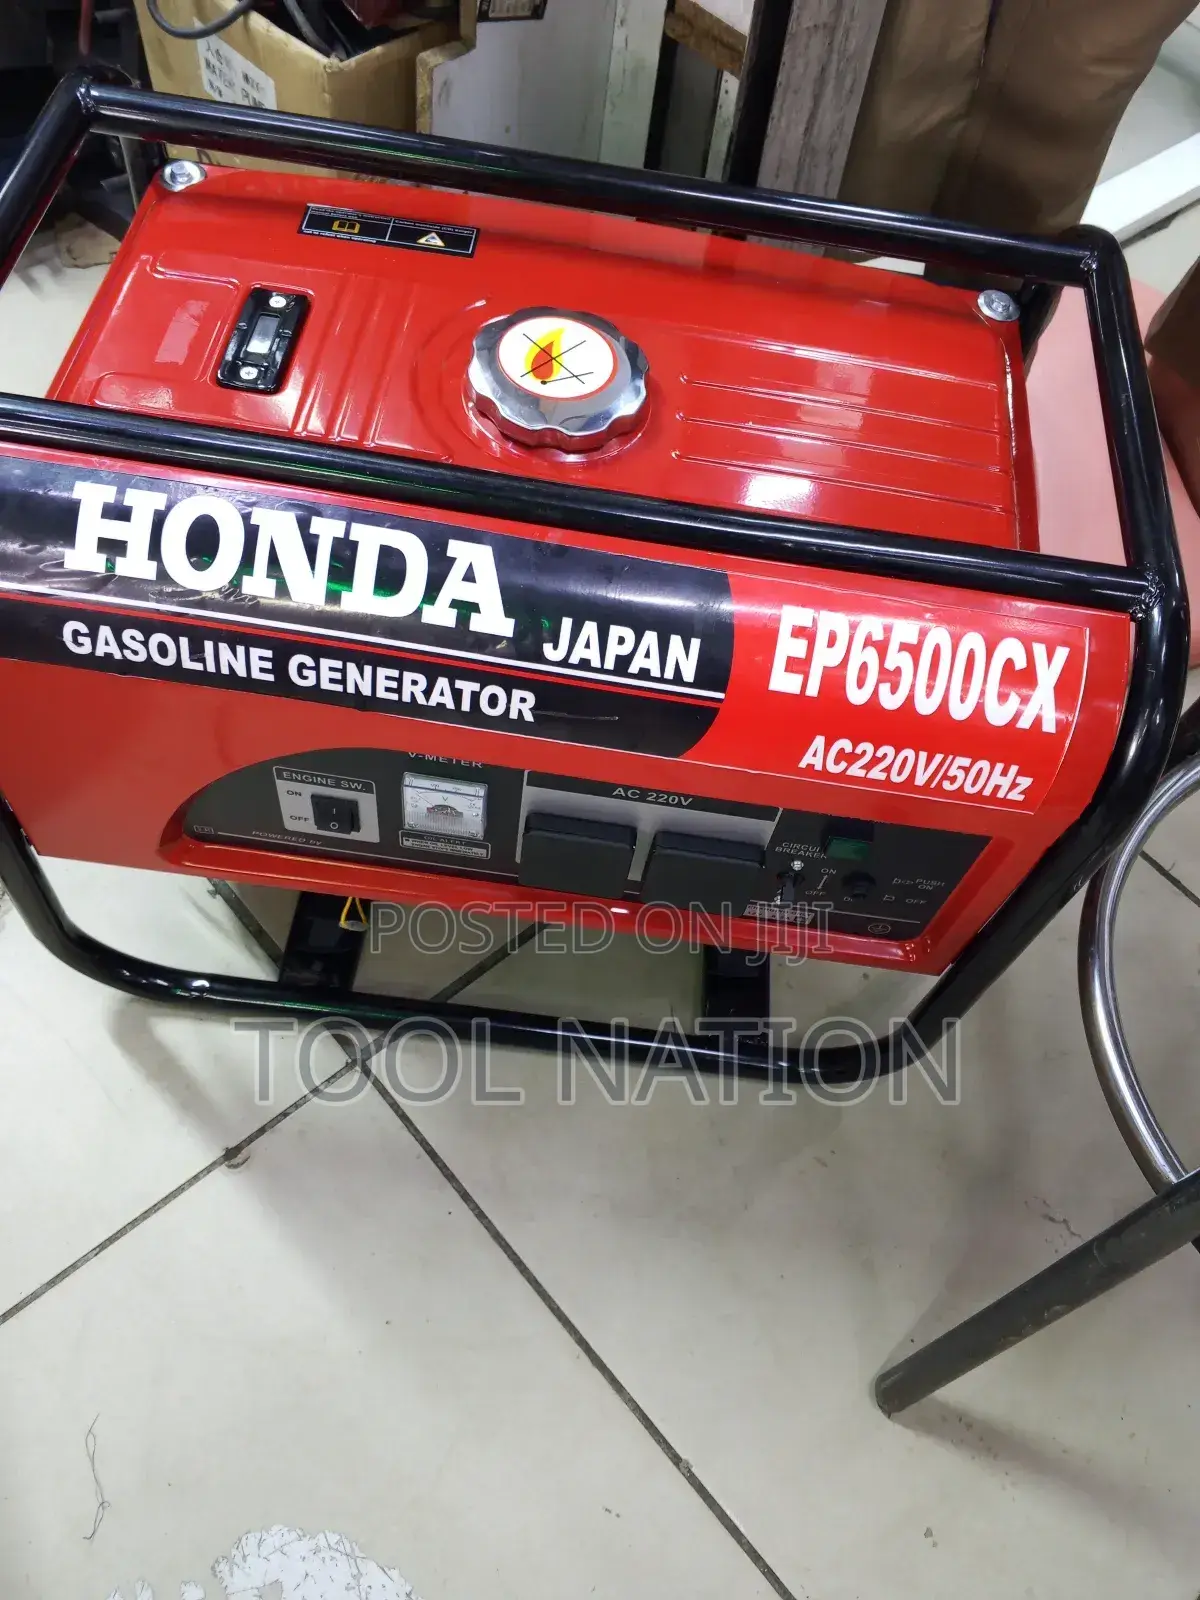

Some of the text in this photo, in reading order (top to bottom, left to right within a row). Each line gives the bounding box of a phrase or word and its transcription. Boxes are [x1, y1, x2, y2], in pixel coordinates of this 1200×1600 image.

[64, 481, 515, 638] HONDA
[542, 616, 701, 683] JAPAN
[62, 620, 537, 723] GASOLINE GENERATOR
[768, 605, 1069, 734] EP6500CX
[799, 735, 1033, 802] AC220V/50Hz
[283, 771, 367, 791] ENGINE SW.
[286, 789, 302, 797] ON
[612, 787, 693, 806] AC 220V
[289, 814, 310, 823] OFF
[252, 830, 307, 844] POWERED
[782, 842, 822, 853] CIRCUI
